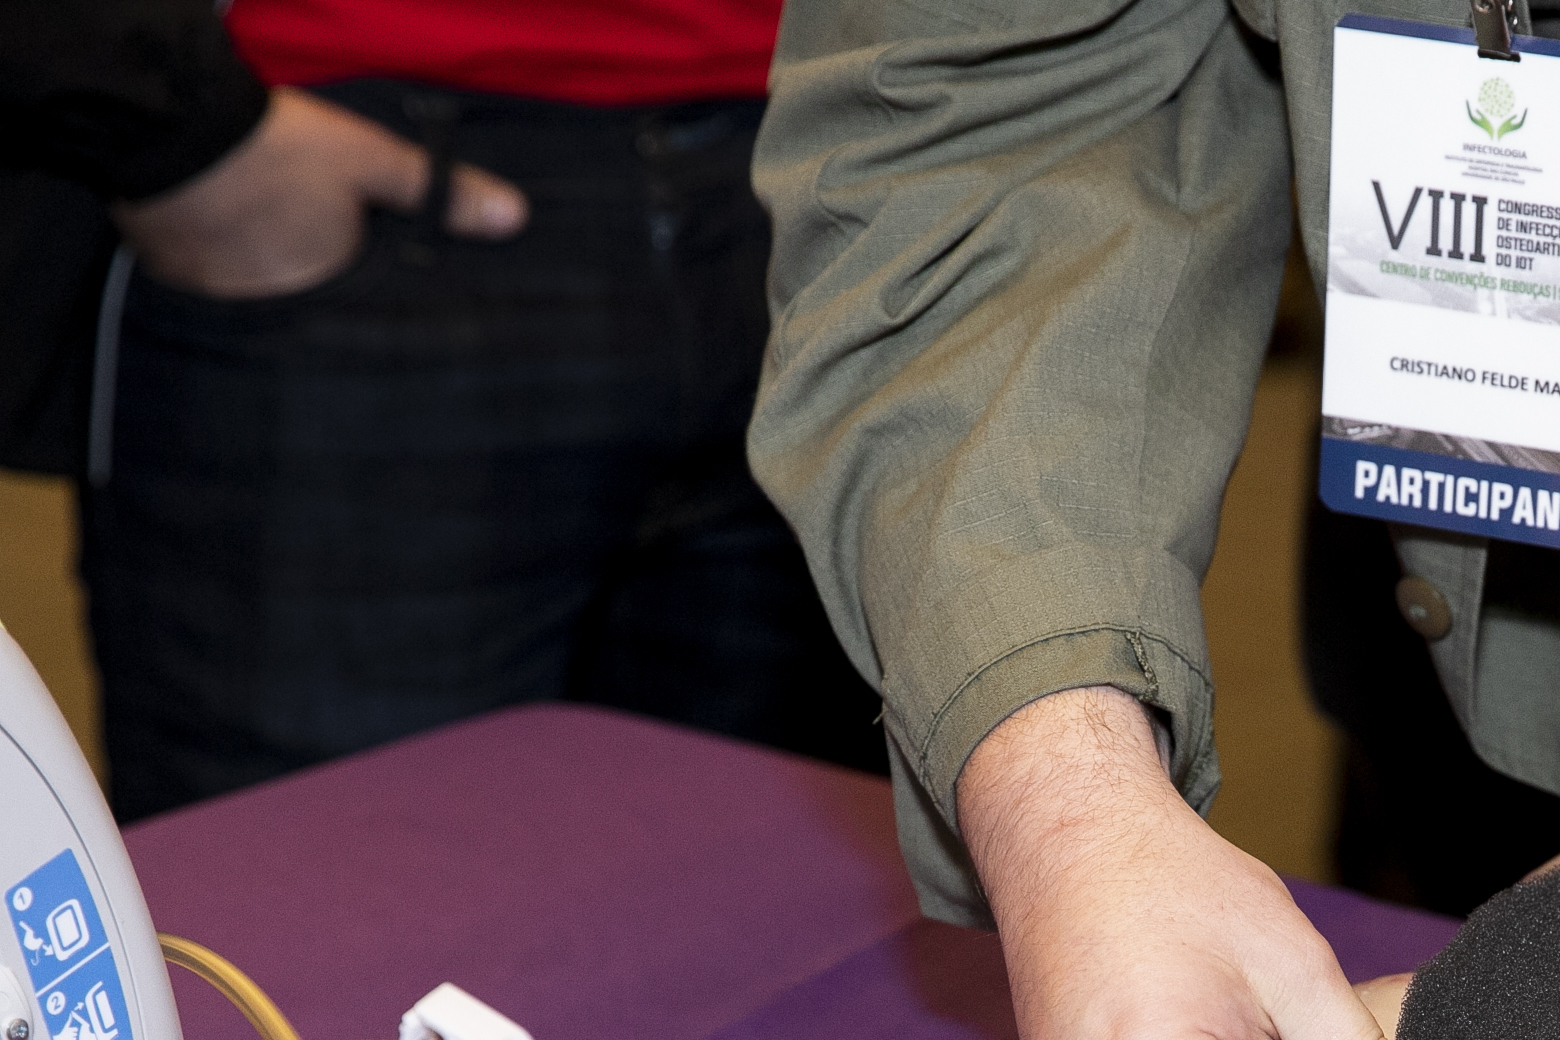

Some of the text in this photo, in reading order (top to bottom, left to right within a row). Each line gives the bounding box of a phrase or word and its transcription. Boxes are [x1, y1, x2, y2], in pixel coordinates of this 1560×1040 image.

[1462, 142, 1528, 160] INFECTOLOGIA
[1371, 179, 1488, 264] VIII
[1497, 216, 1513, 232] DE
[1496, 252, 1535, 271] DO IOT
[1379, 259, 1418, 279] CENTRO
[1418, 265, 1432, 280] DE
[1433, 266, 1498, 291] CONVENÇÕES
[1499, 277, 1552, 300] REBOUÇAS
[1389, 355, 1477, 384] CRISTIANO
[1480, 370, 1529, 392] FELDE
[51, 995, 62, 1011] 2
